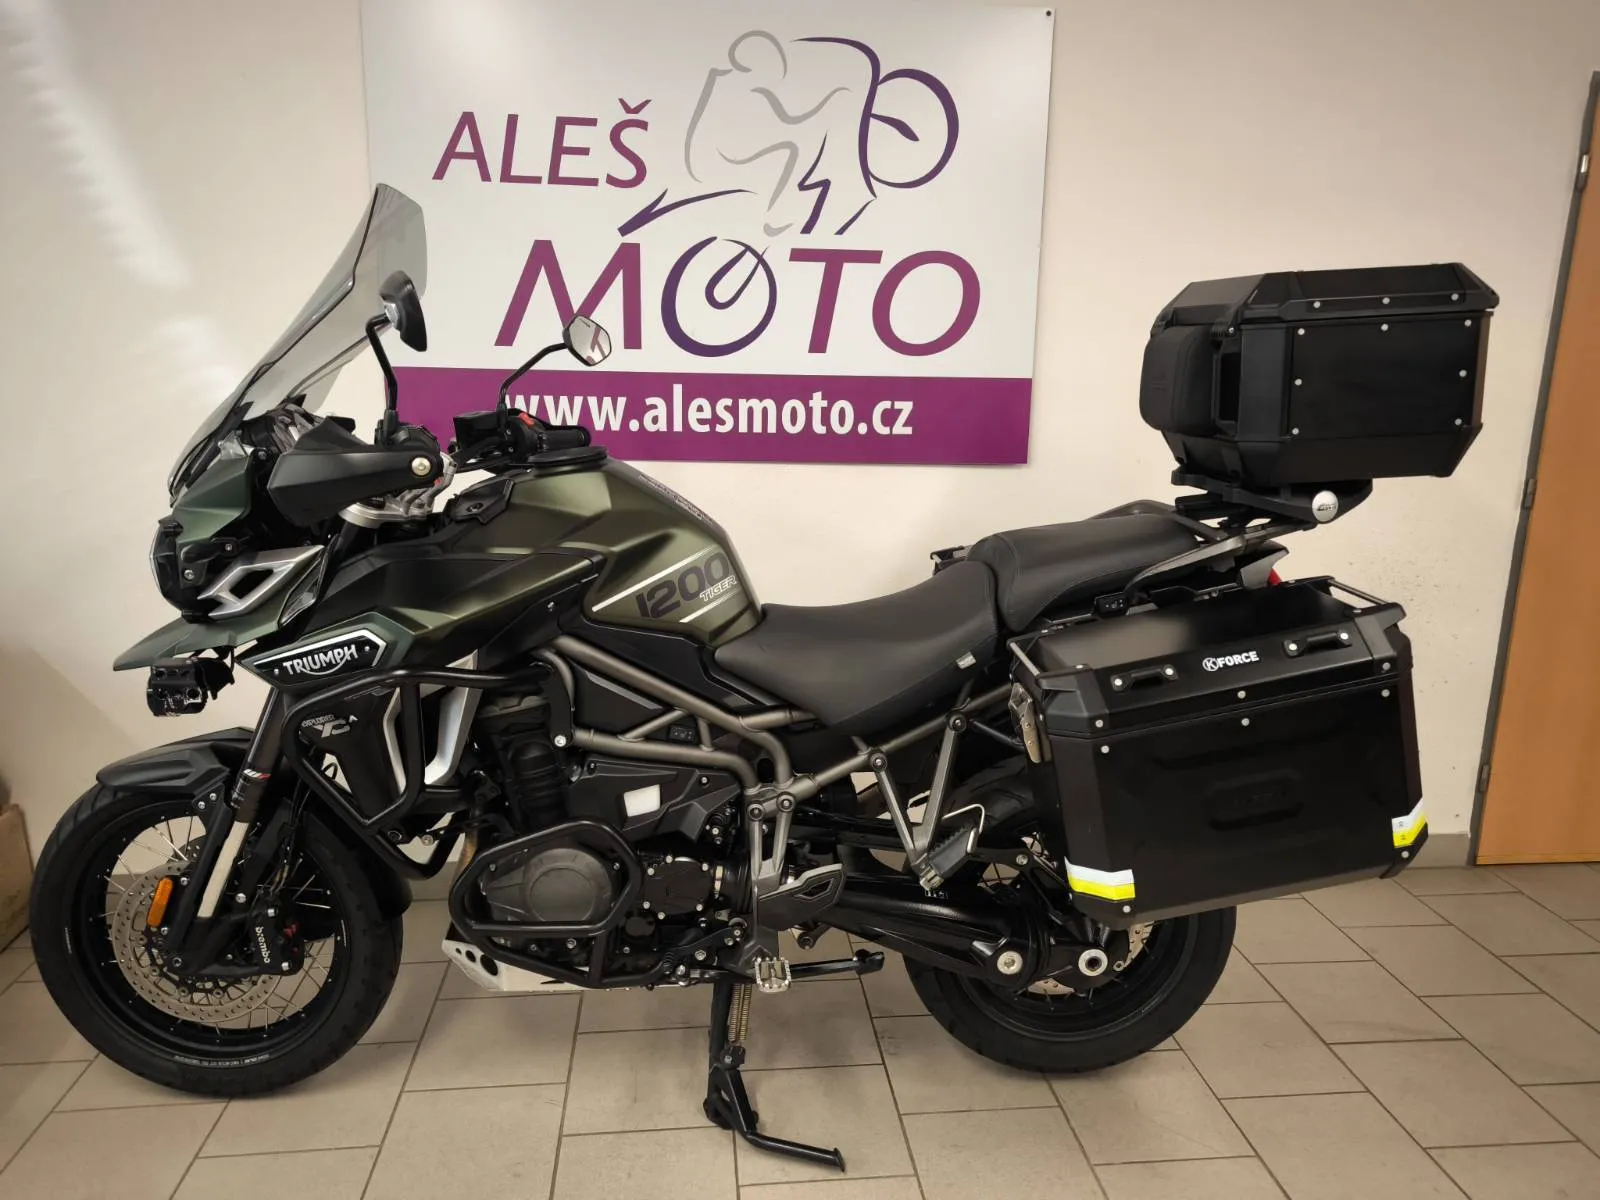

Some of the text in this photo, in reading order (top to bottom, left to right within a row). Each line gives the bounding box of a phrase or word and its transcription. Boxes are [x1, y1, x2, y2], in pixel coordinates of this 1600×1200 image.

[432, 97, 653, 189] ALEŠ
[493, 235, 981, 358] MOTO
[636, 552, 730, 618] 1200
[699, 574, 737, 602] TIGER
[282, 643, 359, 675] TRIUMPH
[254, 926, 271, 964] brembo
